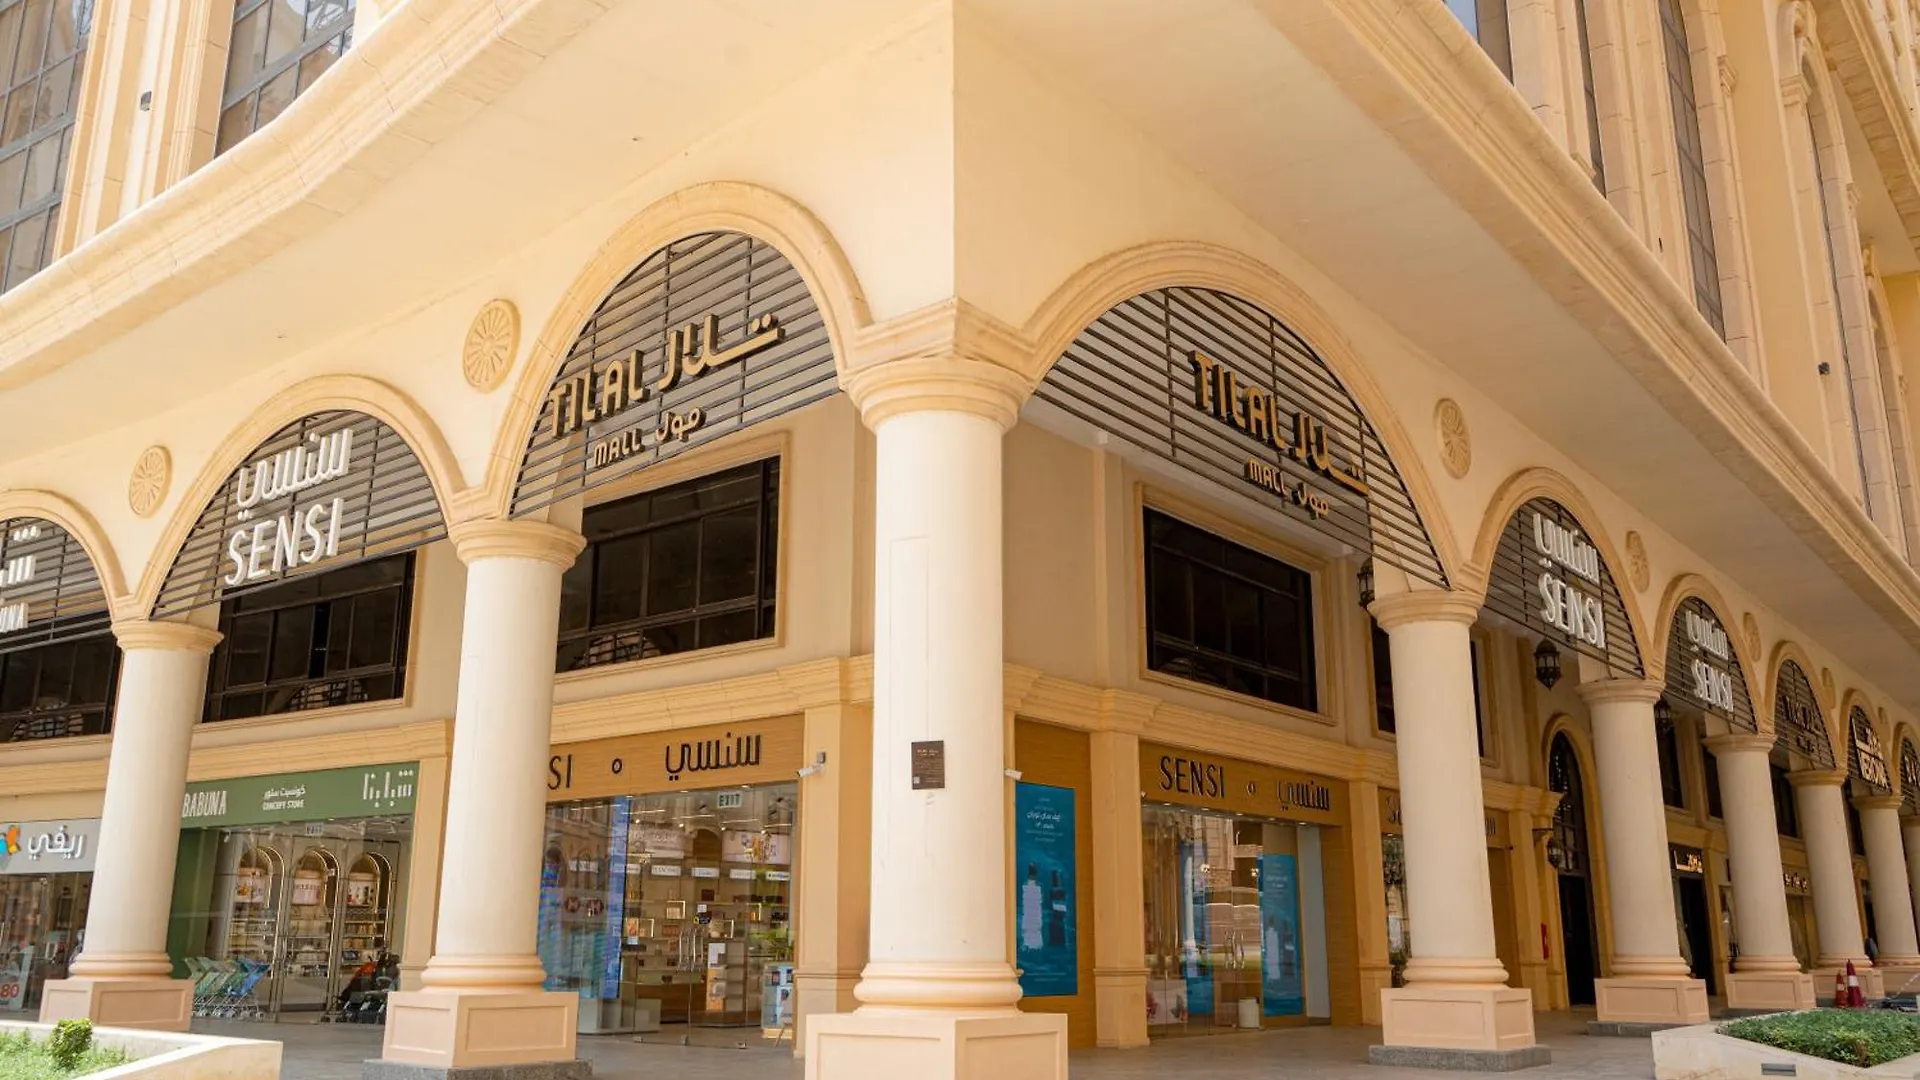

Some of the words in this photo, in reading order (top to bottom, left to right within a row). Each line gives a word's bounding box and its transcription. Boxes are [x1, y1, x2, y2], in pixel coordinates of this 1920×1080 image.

[658, 313, 786, 391] تلال
[550, 350, 649, 439] TILAL
[1188, 350, 1286, 449] TILAL
[594, 428, 645, 468] MALL
[656, 406, 708, 443] مول
[237, 428, 353, 521] سنسي
[1244, 456, 1290, 497] MALL
[1291, 482, 1330, 520] مول
[225, 498, 344, 585] SENSI
[1533, 512, 1600, 585] سنسي
[1539, 573, 1606, 649] SENSI
[1691, 659, 1733, 712] SENSI
[665, 732, 761, 781] سنسي
[1160, 755, 1225, 798] SENSI
[1276, 780, 1331, 811] سنسي
[28, 825, 84, 860] ريفي
